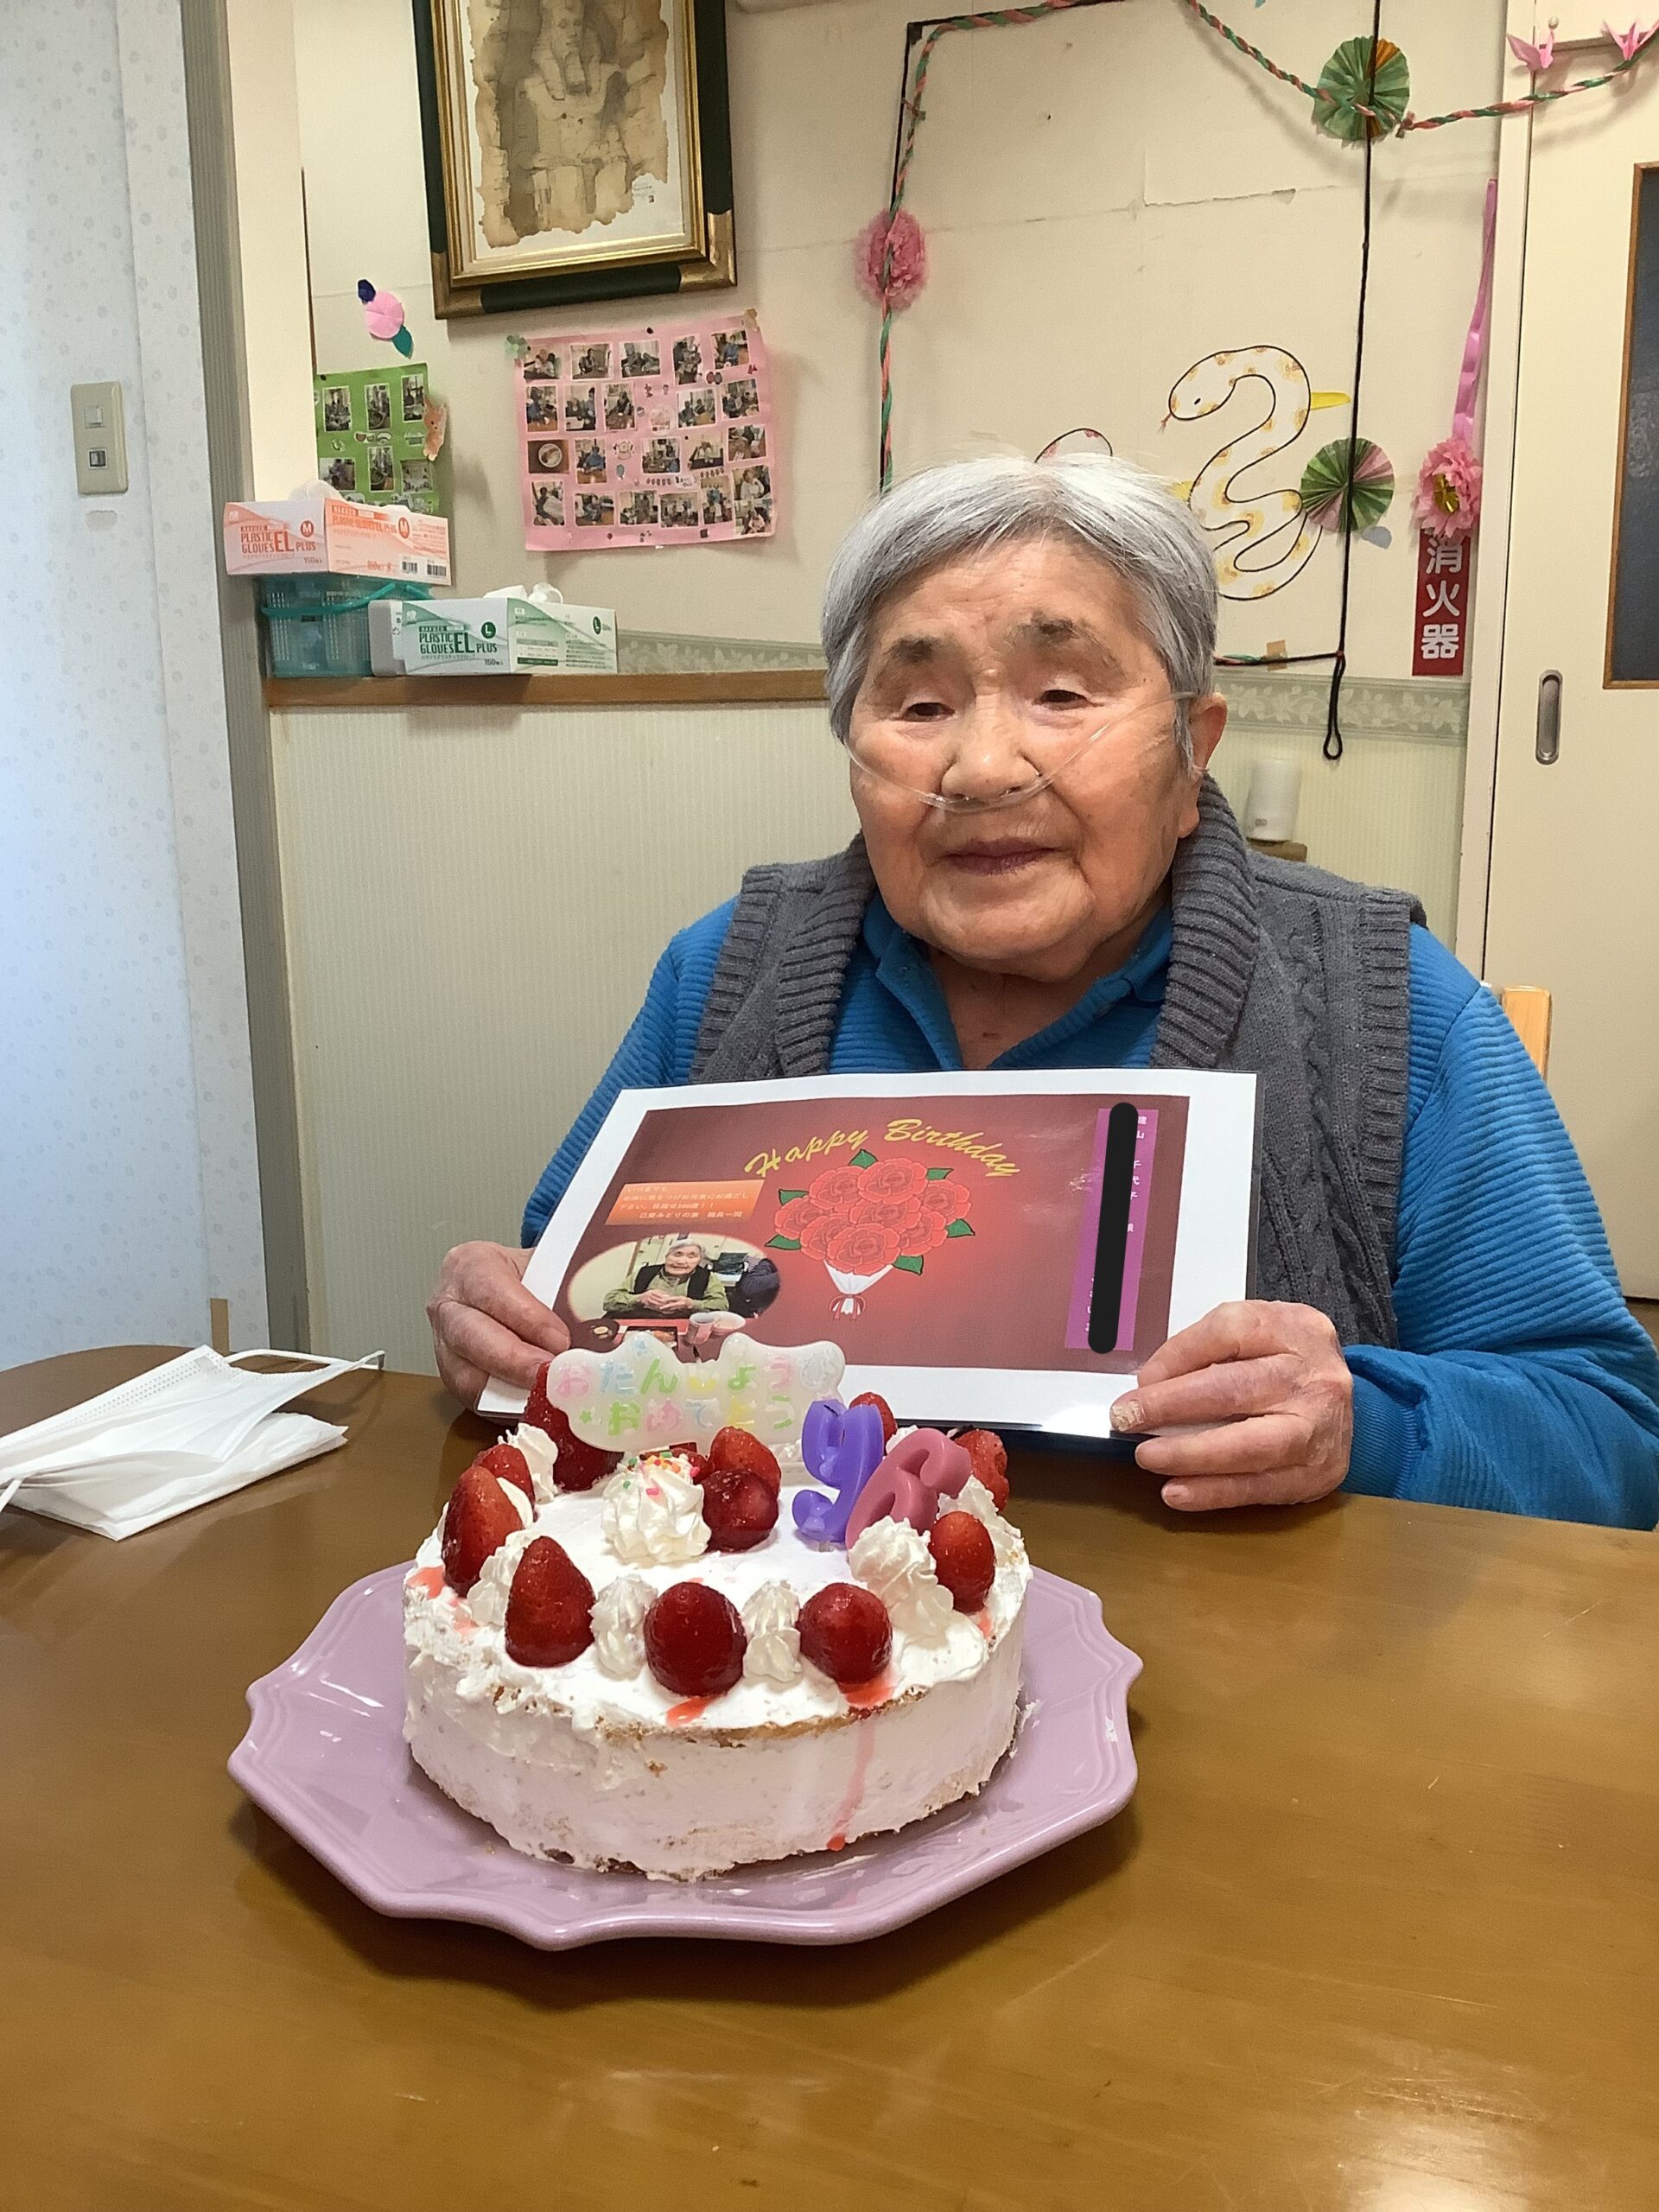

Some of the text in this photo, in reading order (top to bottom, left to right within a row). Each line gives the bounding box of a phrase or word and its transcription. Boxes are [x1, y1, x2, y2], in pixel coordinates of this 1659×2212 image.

[241, 531, 273, 543] PLASTIC
[302, 523, 312, 533] M
[242, 531, 316, 554] GLOVES EL PLUS
[1421, 537, 1463, 659] 消火器
[419, 632, 453, 644] PLASTIC
[485, 624, 493, 635] L
[420, 632, 498, 655] GLOVES EL PLUS
[744, 1118, 1020, 1178] Happy Birthday
[607, 1395, 793, 1436] おめでとう
